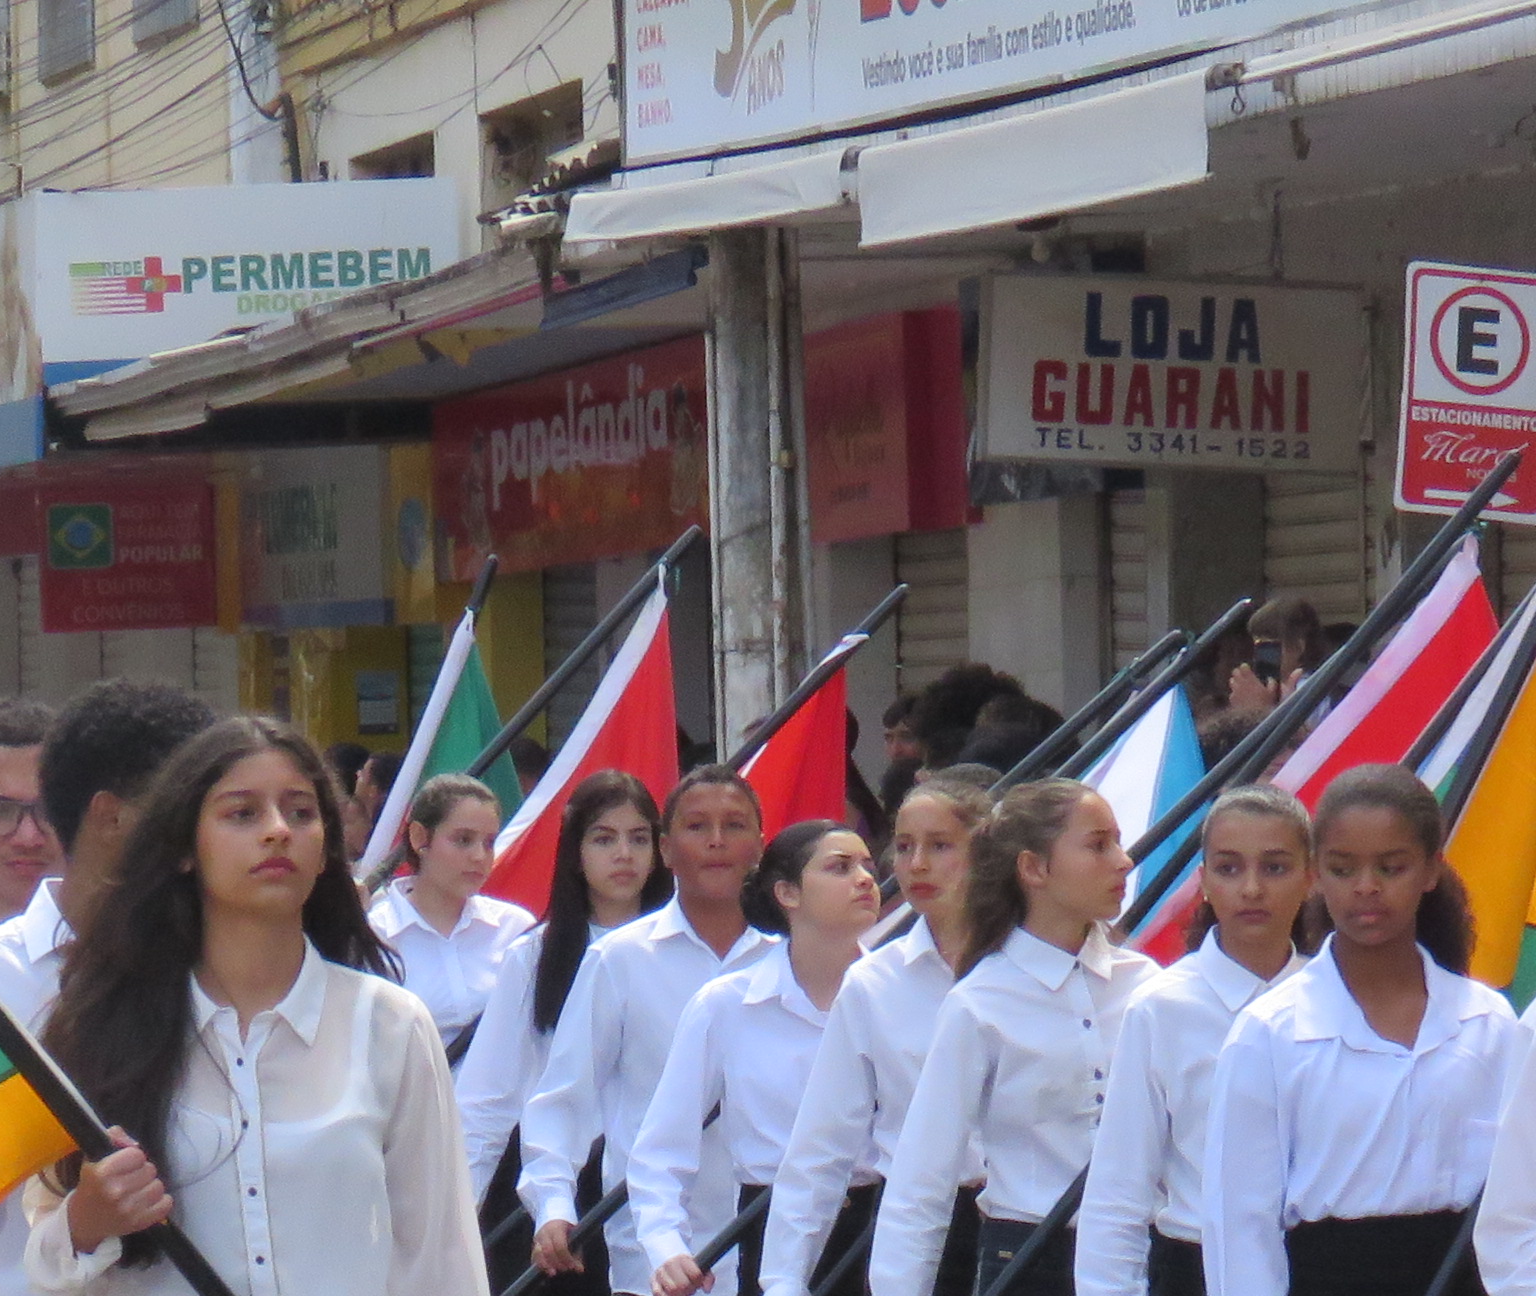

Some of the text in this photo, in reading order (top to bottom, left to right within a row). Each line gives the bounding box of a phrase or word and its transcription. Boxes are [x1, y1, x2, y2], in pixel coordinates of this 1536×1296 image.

[861, 50, 907, 90] Vestindo
[909, 40, 934, 79] você
[935, 47, 943, 73] e
[945, 41, 965, 71] sua
[1005, 28, 1030, 56] com
[1031, 10, 1063, 51] estilo
[1065, 15, 1073, 42] e
[181, 247, 432, 294] PERMEBEM
[1083, 291, 1262, 364] LOJA
[1456, 306, 1500, 375] E
[1031, 359, 1311, 433] GUARANI
[1034, 427, 1105, 451] TEL.
[119, 545, 203, 562] POPULAR
